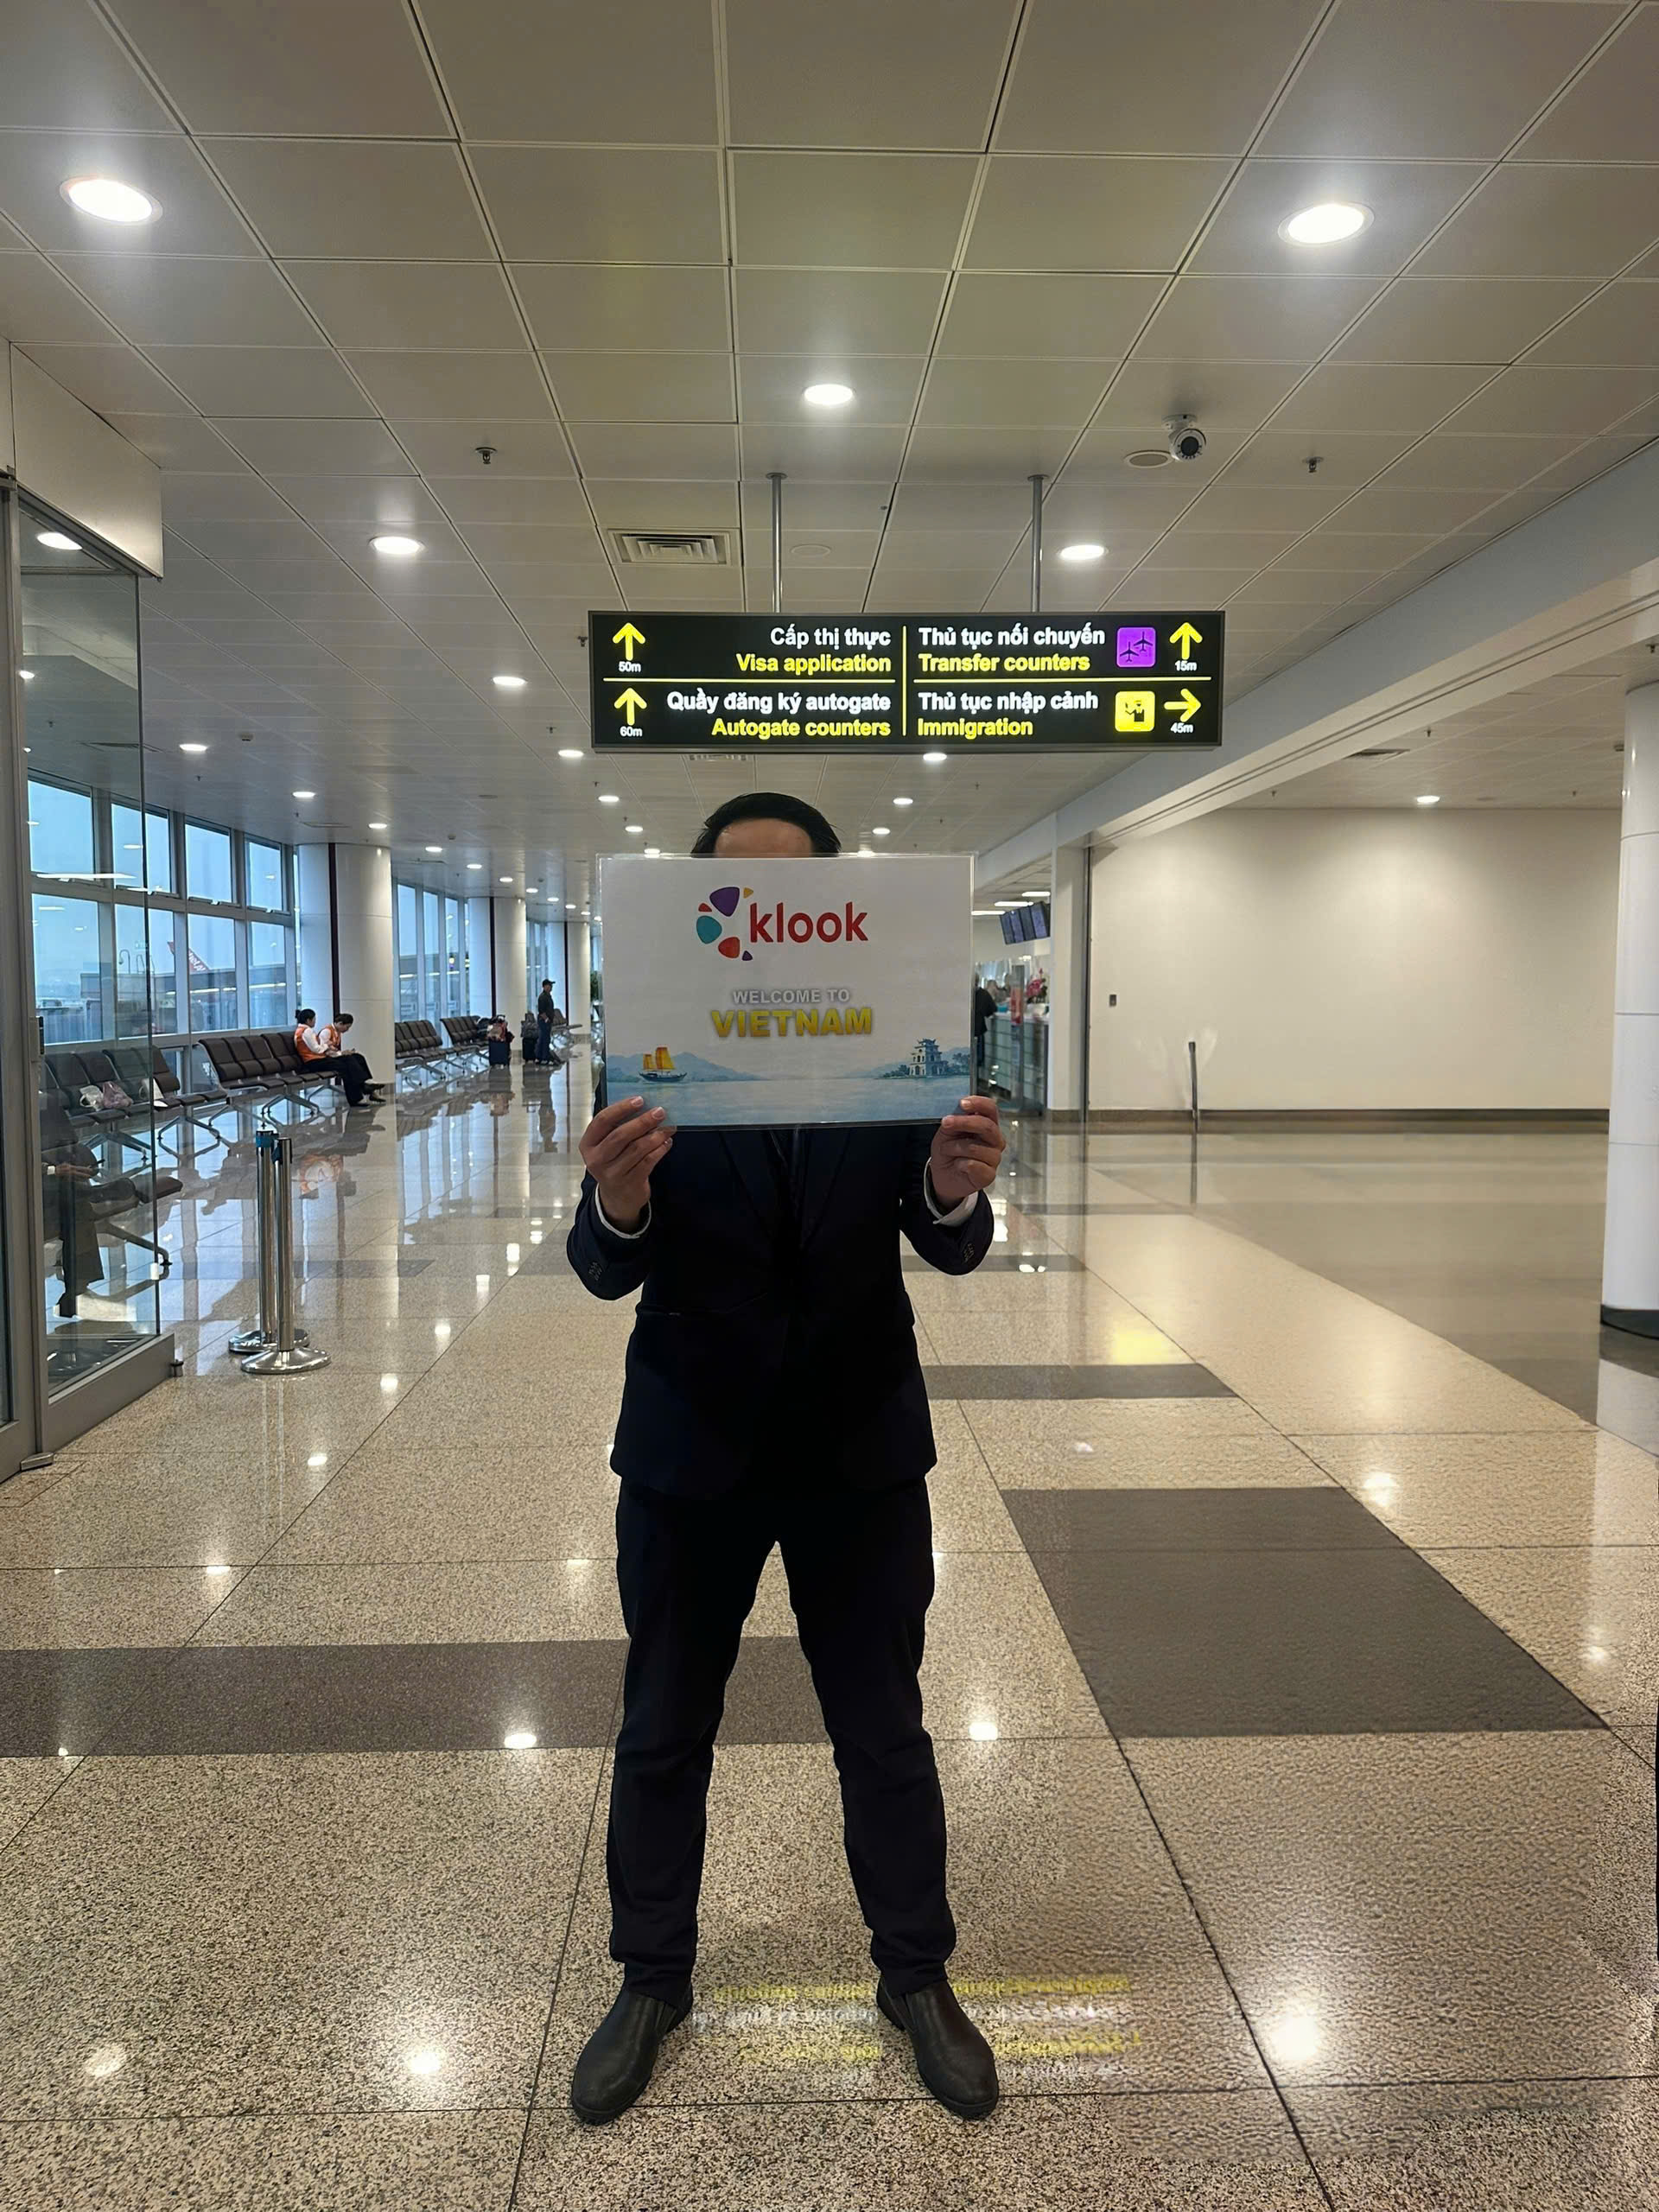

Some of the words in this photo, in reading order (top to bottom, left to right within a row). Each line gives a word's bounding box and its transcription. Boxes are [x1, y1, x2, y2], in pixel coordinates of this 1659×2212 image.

[771, 624, 809, 649] Cấp
[814, 628, 839, 650] thị
[844, 628, 891, 650] thực
[918, 627, 956, 645] Thủ
[961, 628, 993, 650] tục
[998, 623, 1028, 645] nối
[1033, 622, 1105, 649] chuyến
[619, 662, 641, 673] 50m
[736, 653, 779, 671] Visa
[784, 654, 891, 676] application
[918, 653, 1000, 671] Transfer
[1004, 653, 1090, 671] counters
[1175, 661, 1197, 671] 15m
[667, 688, 719, 714] Quầy
[724, 692, 772, 714] đăng
[779, 692, 802, 714] ký
[806, 693, 891, 715] autogate
[918, 692, 956, 710] Thủ
[961, 693, 992, 715] tục
[997, 691, 1046, 714] nhập
[1051, 691, 1098, 709] cảnh
[620, 727, 643, 737] 60m
[712, 718, 800, 740] Autogate
[805, 719, 891, 736] counters
[918, 718, 1033, 740] Immigration
[1170, 723, 1193, 734] 45m
[750, 901, 868, 944] klook
[733, 989, 820, 1003] WELCOME
[829, 989, 850, 1001] TO
[711, 1007, 873, 1038] VIETNAM
